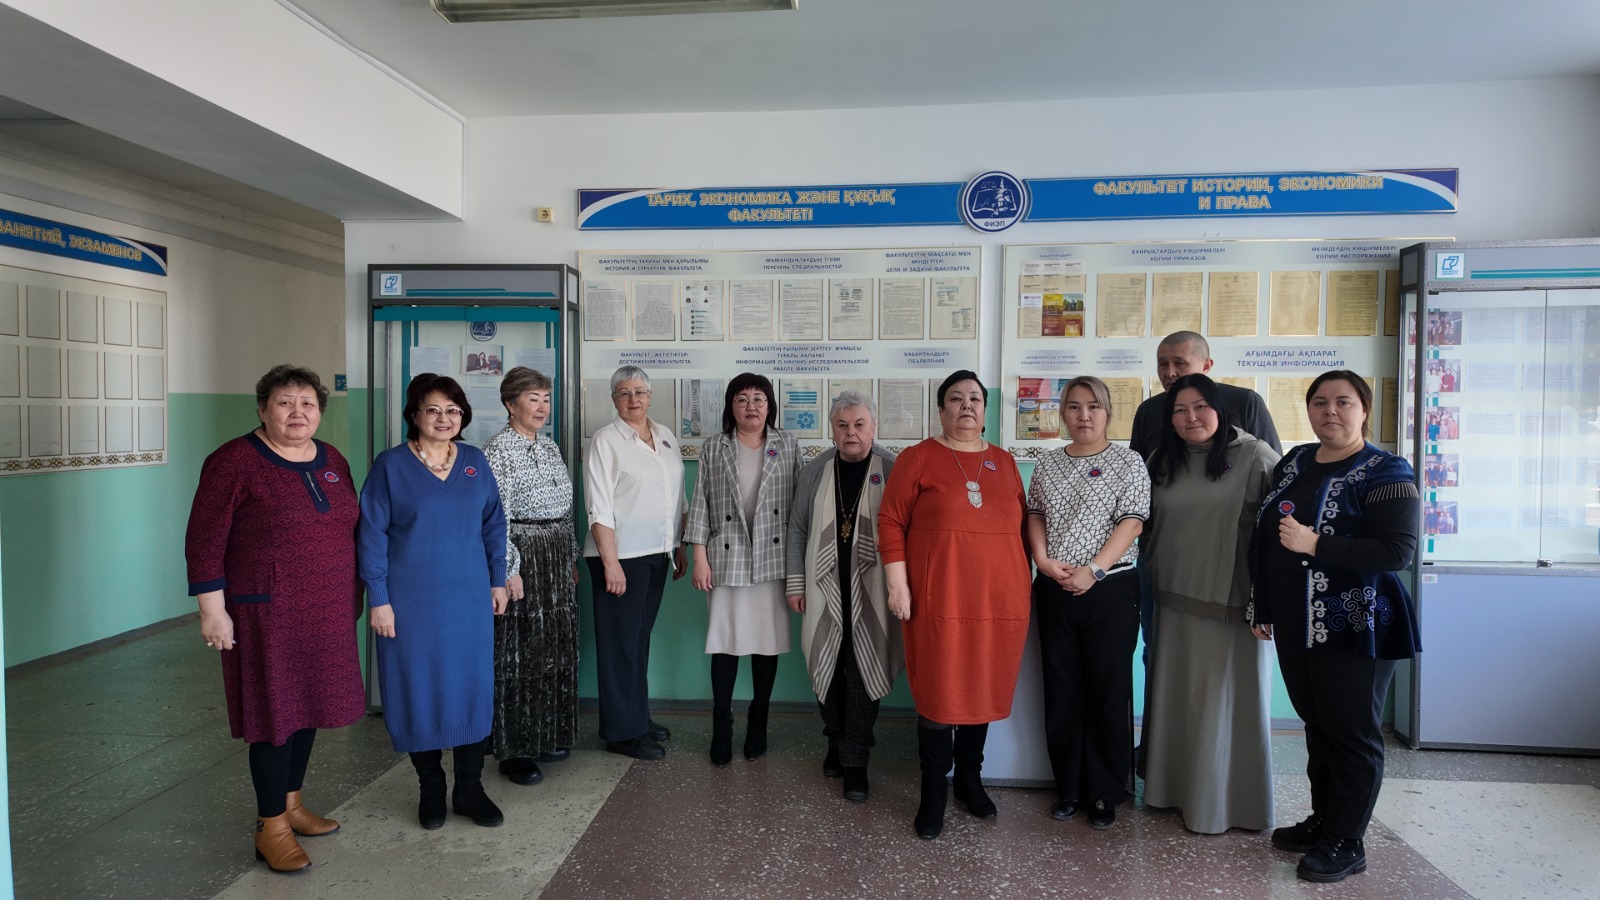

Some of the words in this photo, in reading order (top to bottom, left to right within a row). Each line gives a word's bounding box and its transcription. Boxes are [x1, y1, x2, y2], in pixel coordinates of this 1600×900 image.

[1093, 179, 1188, 195] ФАКУЛЬТЕТ
[1191, 177, 1274, 193] ИСТОРИИ,
[1278, 175, 1384, 191] ЭКОНОМИКИ
[646, 192, 697, 207] ТАРИХ,
[699, 191, 793, 206] ЭКОНОМИКА
[795, 190, 840, 205] ЖӘНЕ
[843, 188, 896, 206] ҚҰҚЫҚ
[1198, 195, 1211, 210] И
[1215, 194, 1272, 210] ПРАВА
[727, 207, 813, 222] ФАКУЛЬТЕТІ
[69, 234, 143, 262] ЭКЗАМЕНОВ
[1298, 350, 1338, 358] АҚПАРАТ
